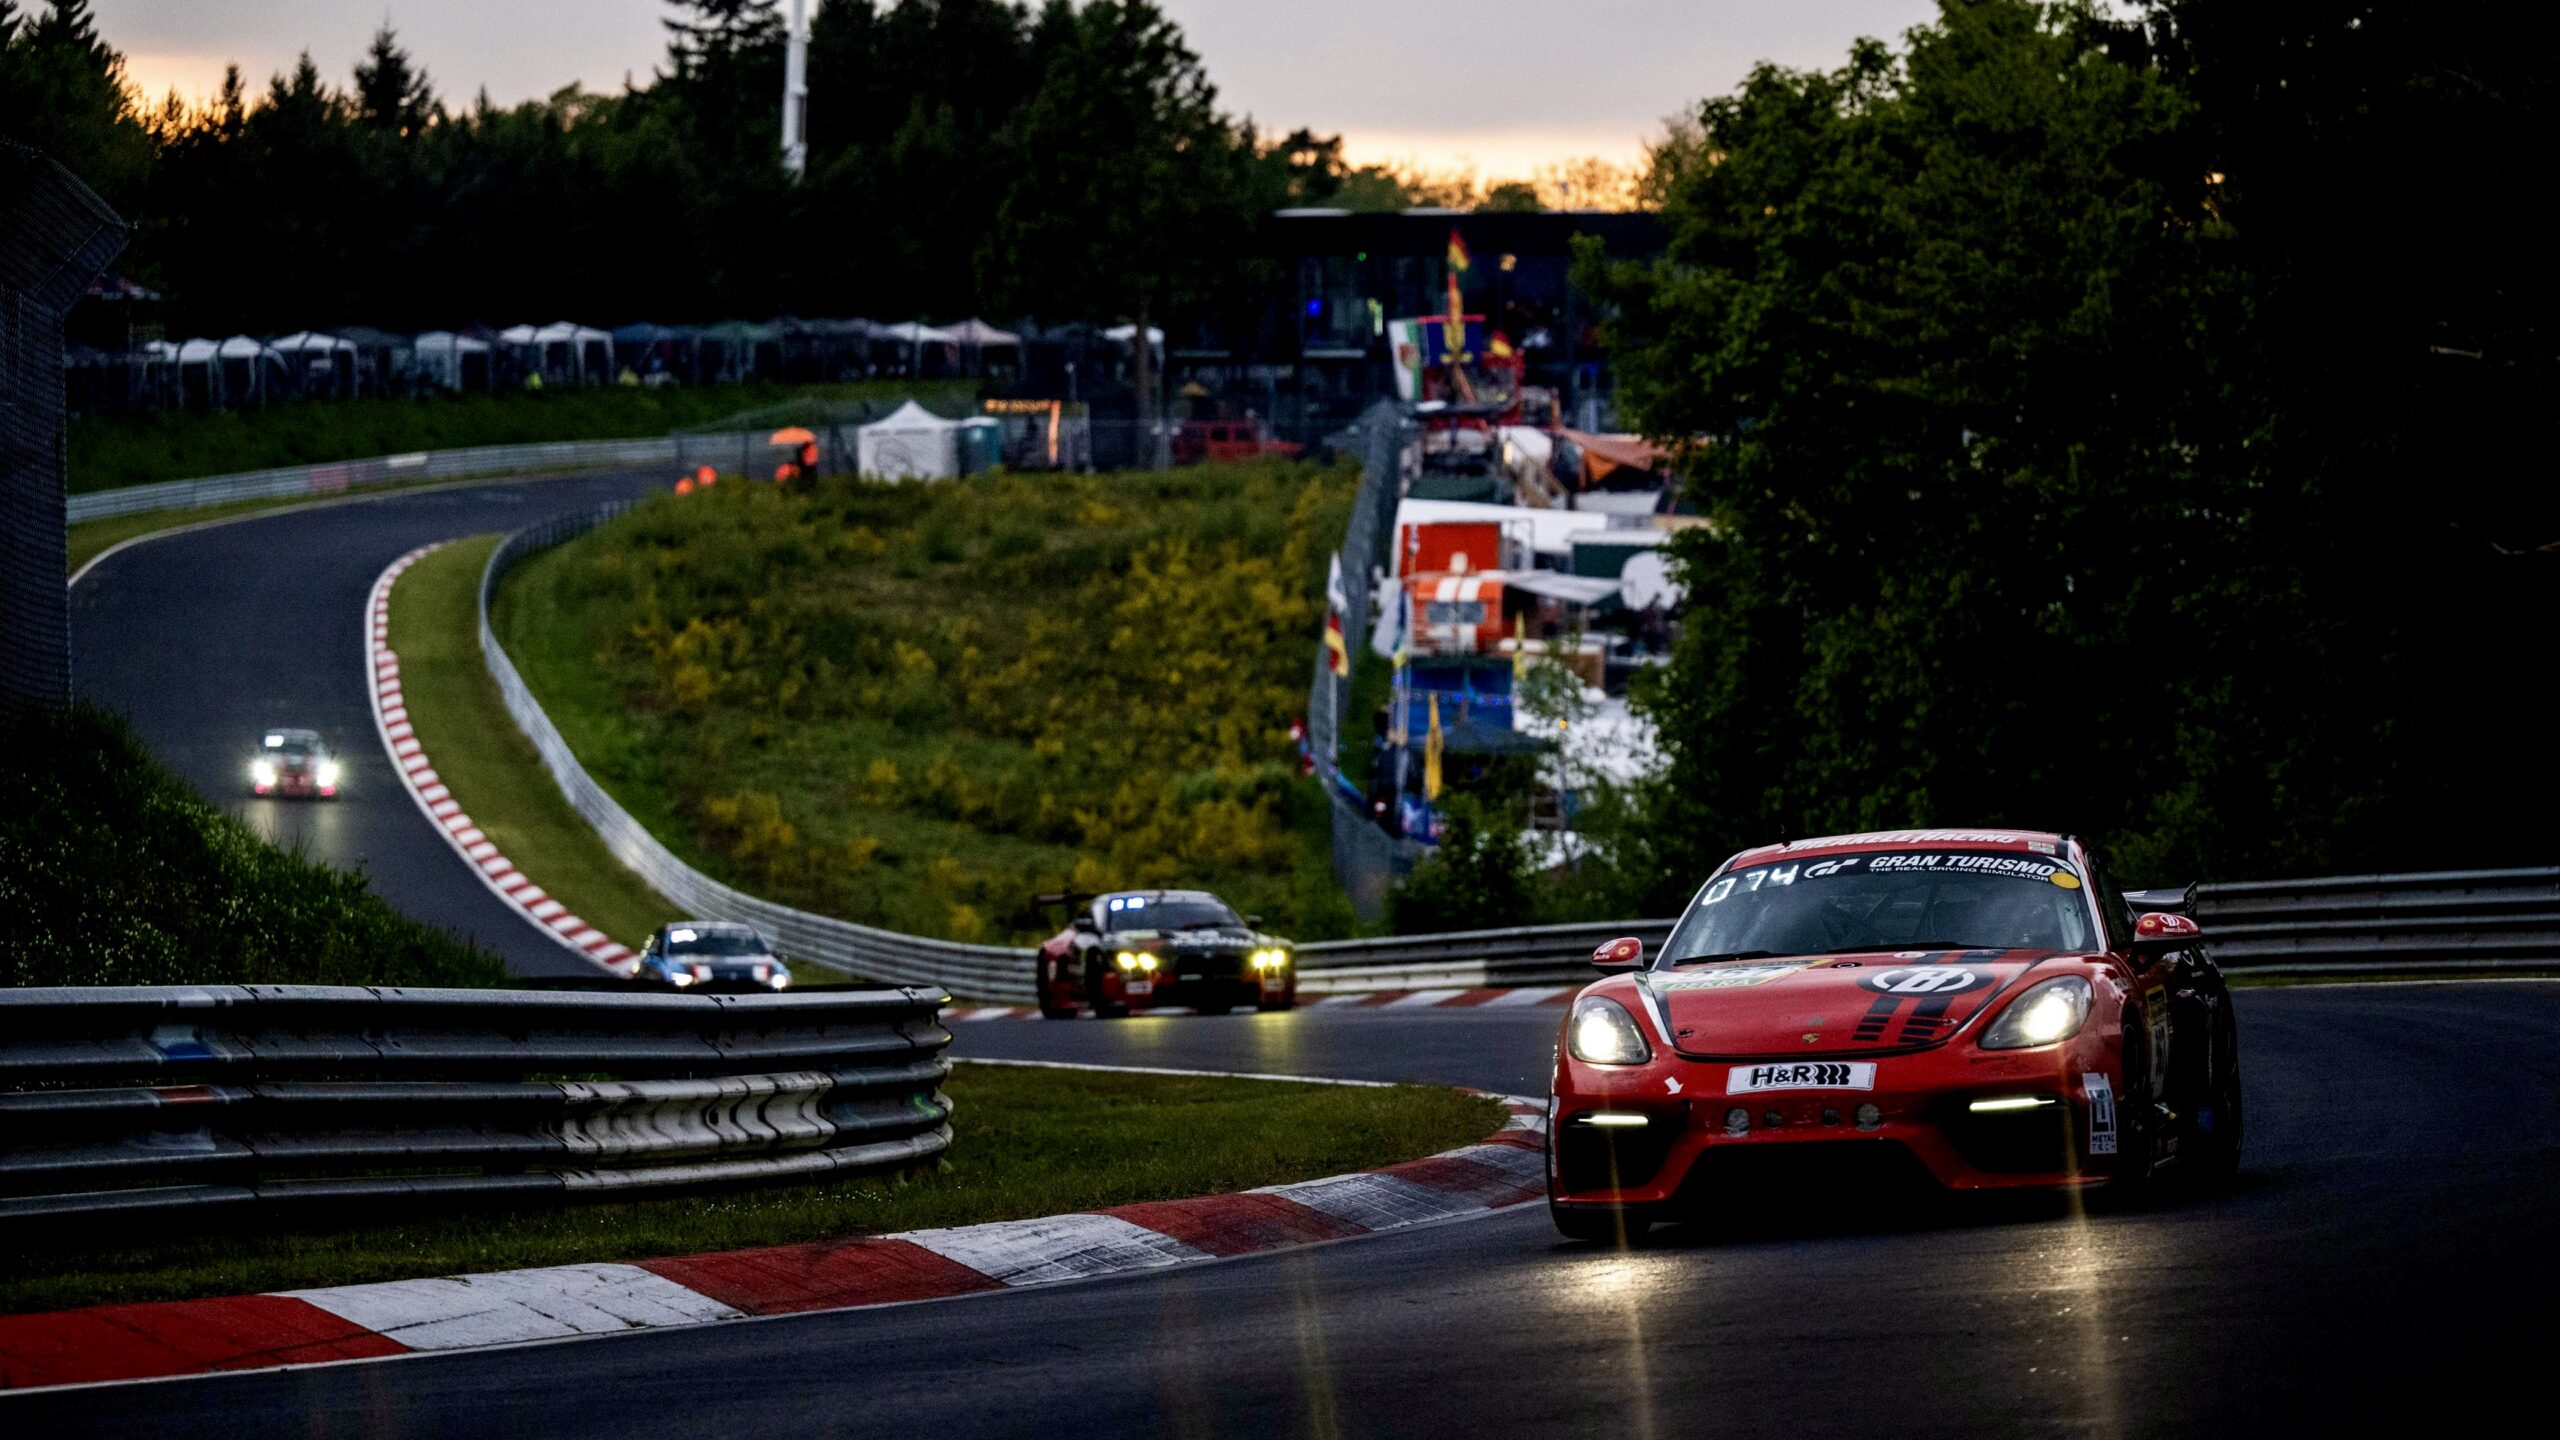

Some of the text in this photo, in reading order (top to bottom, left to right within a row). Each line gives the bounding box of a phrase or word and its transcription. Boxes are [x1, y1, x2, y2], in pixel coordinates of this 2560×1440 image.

[1869, 855, 2056, 877] GRAN TURISMO
[1980, 867, 2049, 882] SIMULATOR
[1701, 864, 1799, 906] 074
[1751, 1065, 1811, 1087] H&R
[2092, 1134, 2115, 1143] METAL
[2092, 1143, 2116, 1151] TECH
